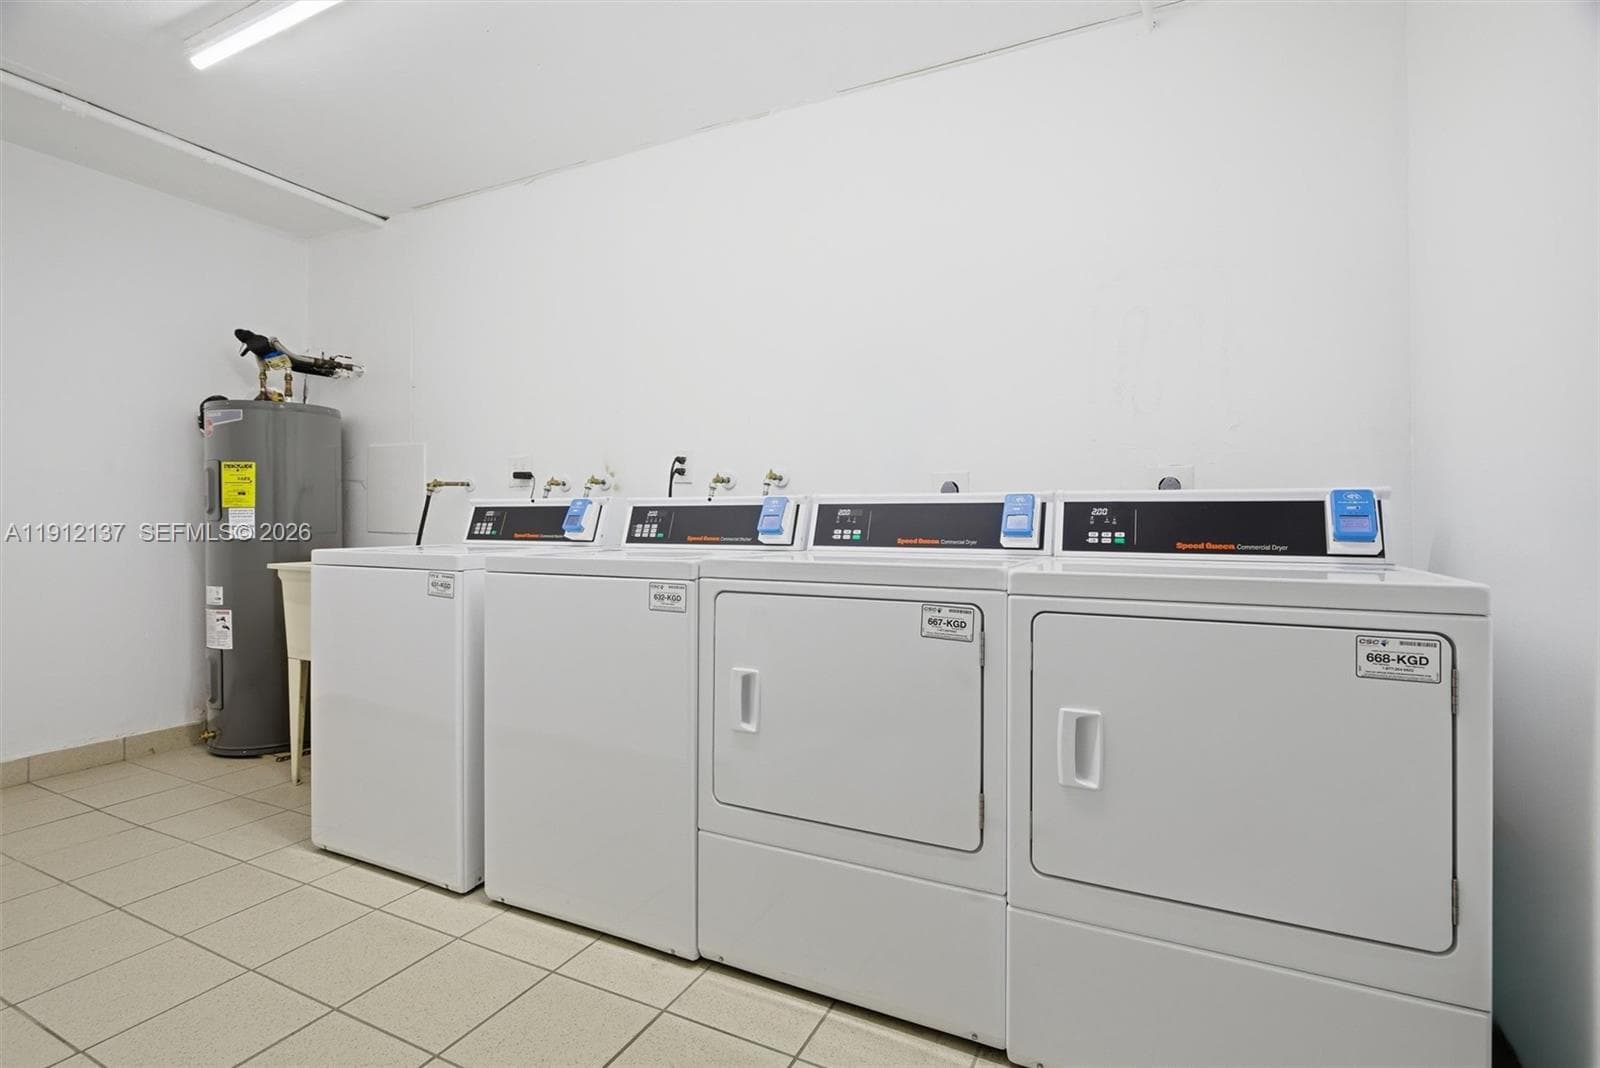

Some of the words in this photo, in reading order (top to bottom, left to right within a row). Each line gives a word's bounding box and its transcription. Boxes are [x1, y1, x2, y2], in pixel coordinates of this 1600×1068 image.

[897, 537, 918, 545] Speed
[918, 537, 940, 545] Queen
[1175, 542, 1205, 550] Speed
[1205, 542, 1235, 550] Queen
[1236, 543, 1271, 551] Commercial
[1271, 544, 1289, 552] Dryer
[653, 593, 682, 602] 632-KGD
[927, 617, 967, 629] 667-KGD
[1366, 652, 1430, 666] 668-KGD
